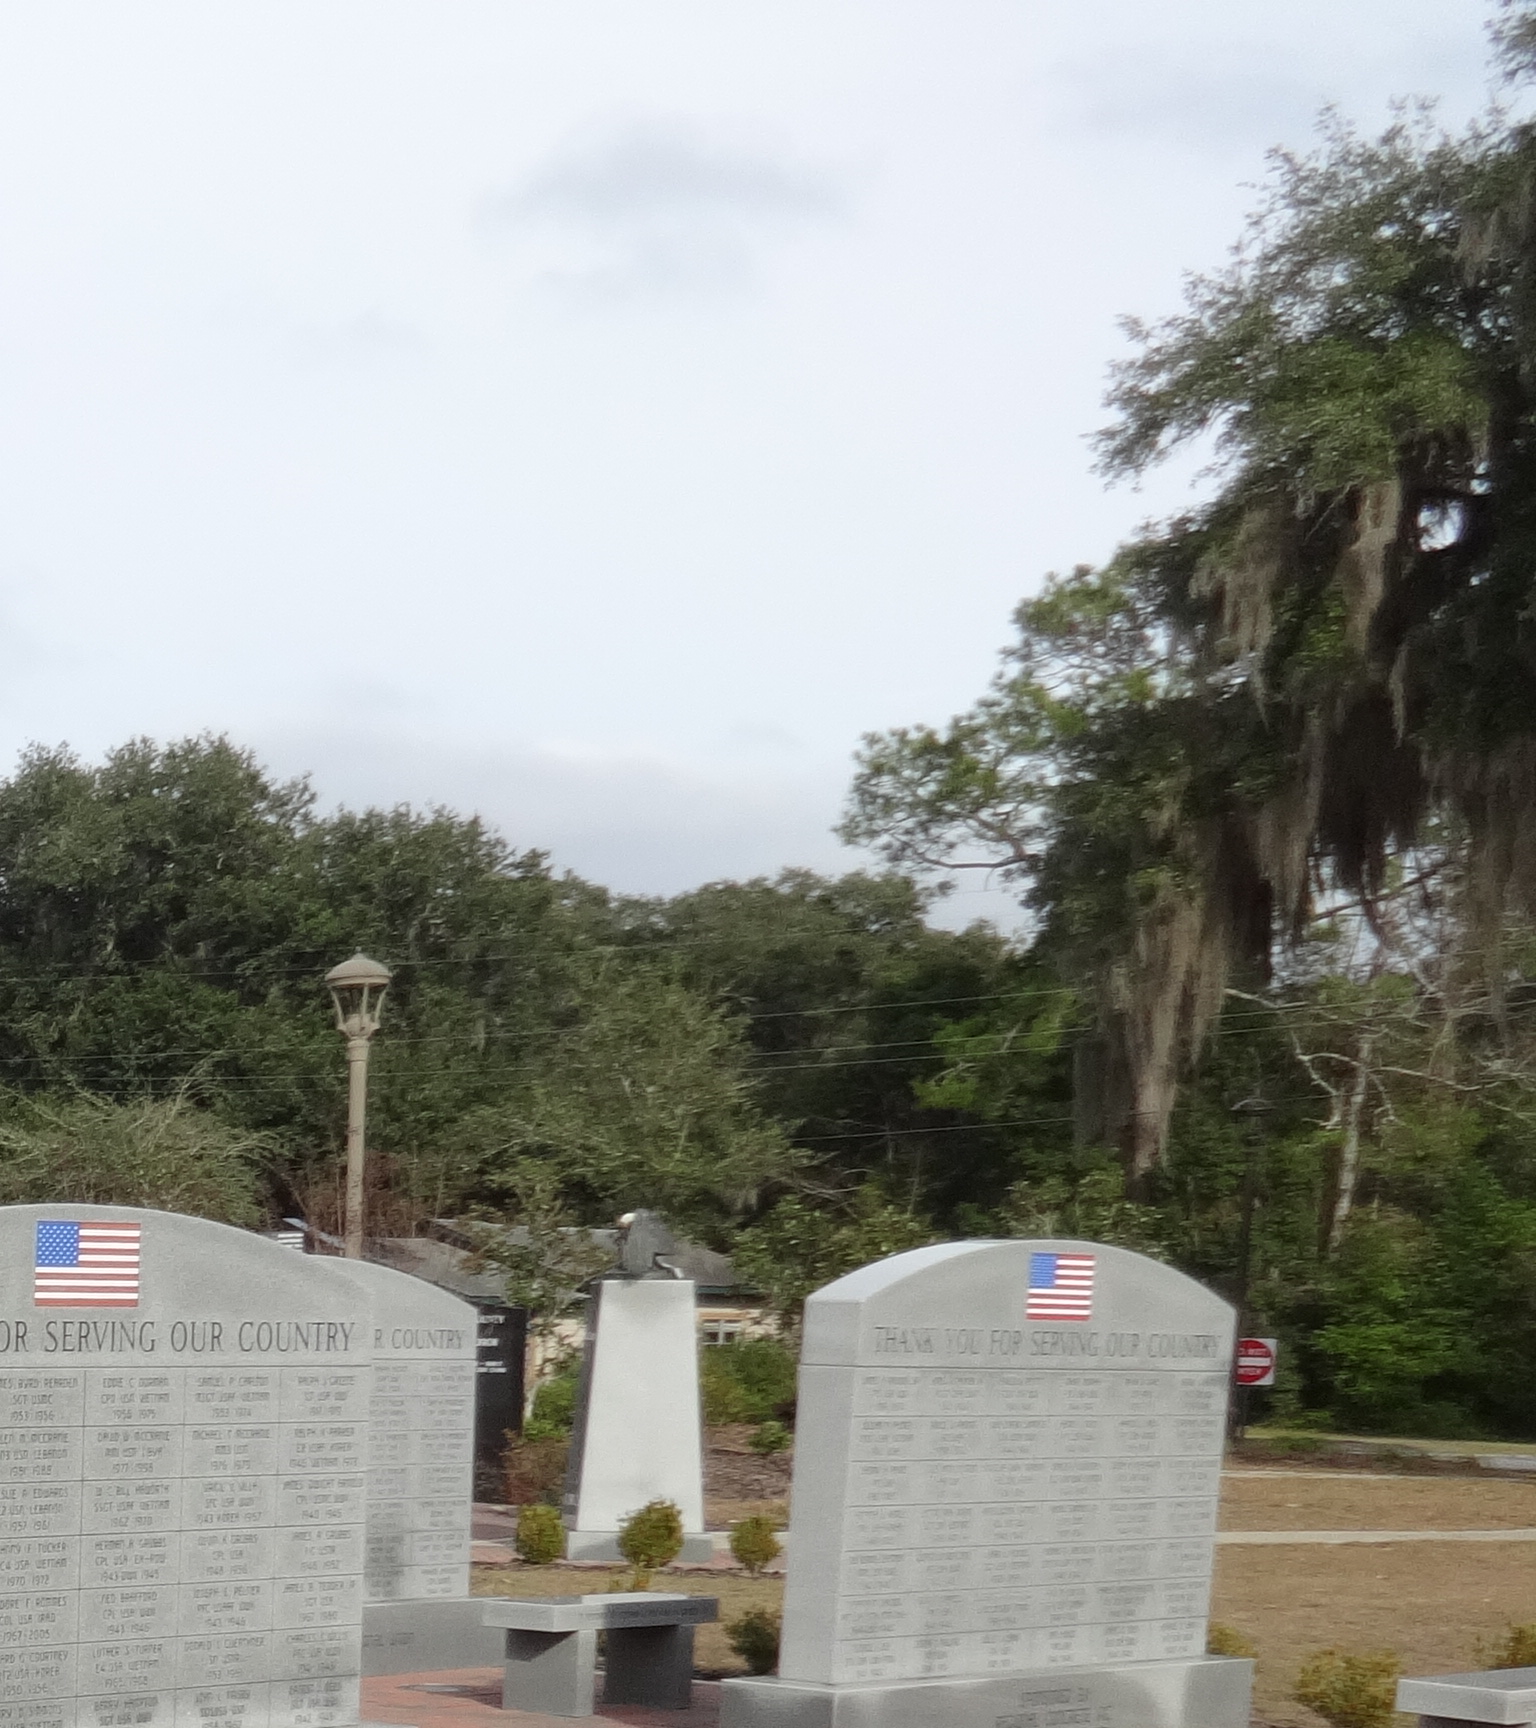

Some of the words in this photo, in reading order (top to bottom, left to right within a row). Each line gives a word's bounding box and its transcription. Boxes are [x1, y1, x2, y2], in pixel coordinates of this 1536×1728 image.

[44, 1321, 156, 1354] SERVING
[170, 1322, 222, 1353] OUR
[238, 1322, 355, 1354] COUNTRY
[391, 1329, 464, 1349] COUNTRY
[875, 1326, 937, 1354] THANK
[991, 1330, 1021, 1356] FOR
[1030, 1331, 1098, 1357] SERVING
[1107, 1333, 1139, 1358] OUR
[1148, 1334, 1221, 1359] COUNTRY
